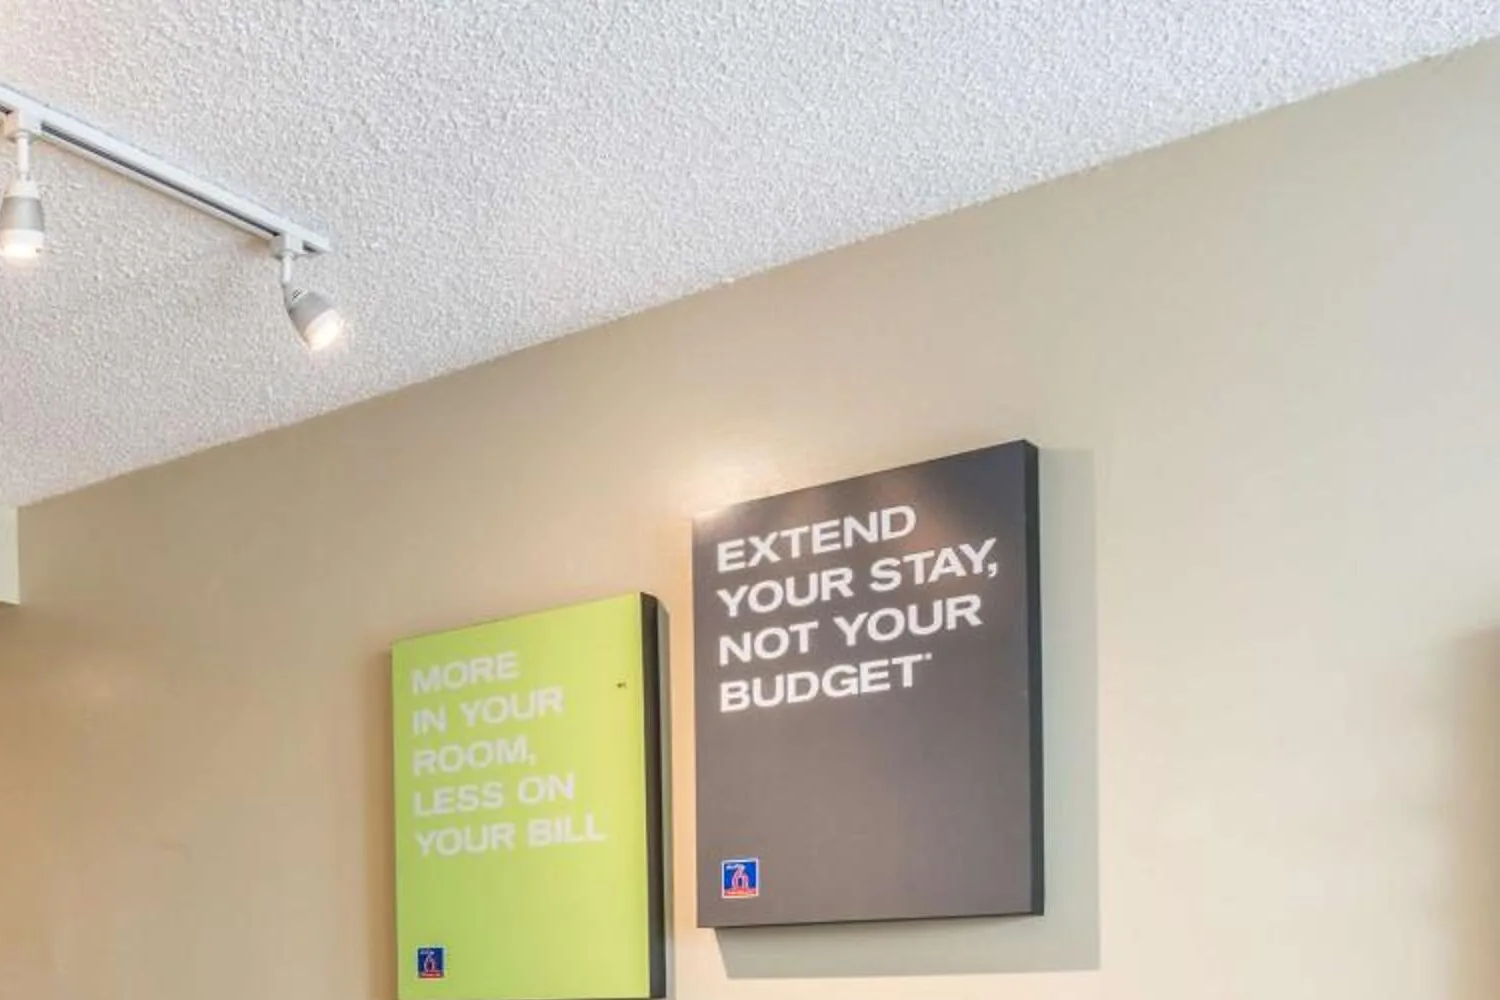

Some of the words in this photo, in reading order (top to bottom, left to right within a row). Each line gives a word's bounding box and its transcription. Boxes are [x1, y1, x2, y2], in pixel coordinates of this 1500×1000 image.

[717, 505, 916, 572] EXTEND
[716, 567, 854, 618] YOUR
[869, 537, 999, 593] STAY,
[719, 621, 819, 666] NOT
[834, 594, 984, 647] YOUR
[411, 651, 520, 696] MORE
[412, 706, 447, 735] IN
[459, 685, 566, 726] YOUR
[412, 734, 537, 777] ROOM,
[413, 780, 504, 817] LESS
[517, 772, 576, 806] ON
[415, 822, 517, 857] YOUR
[526, 812, 607, 847] BILL
